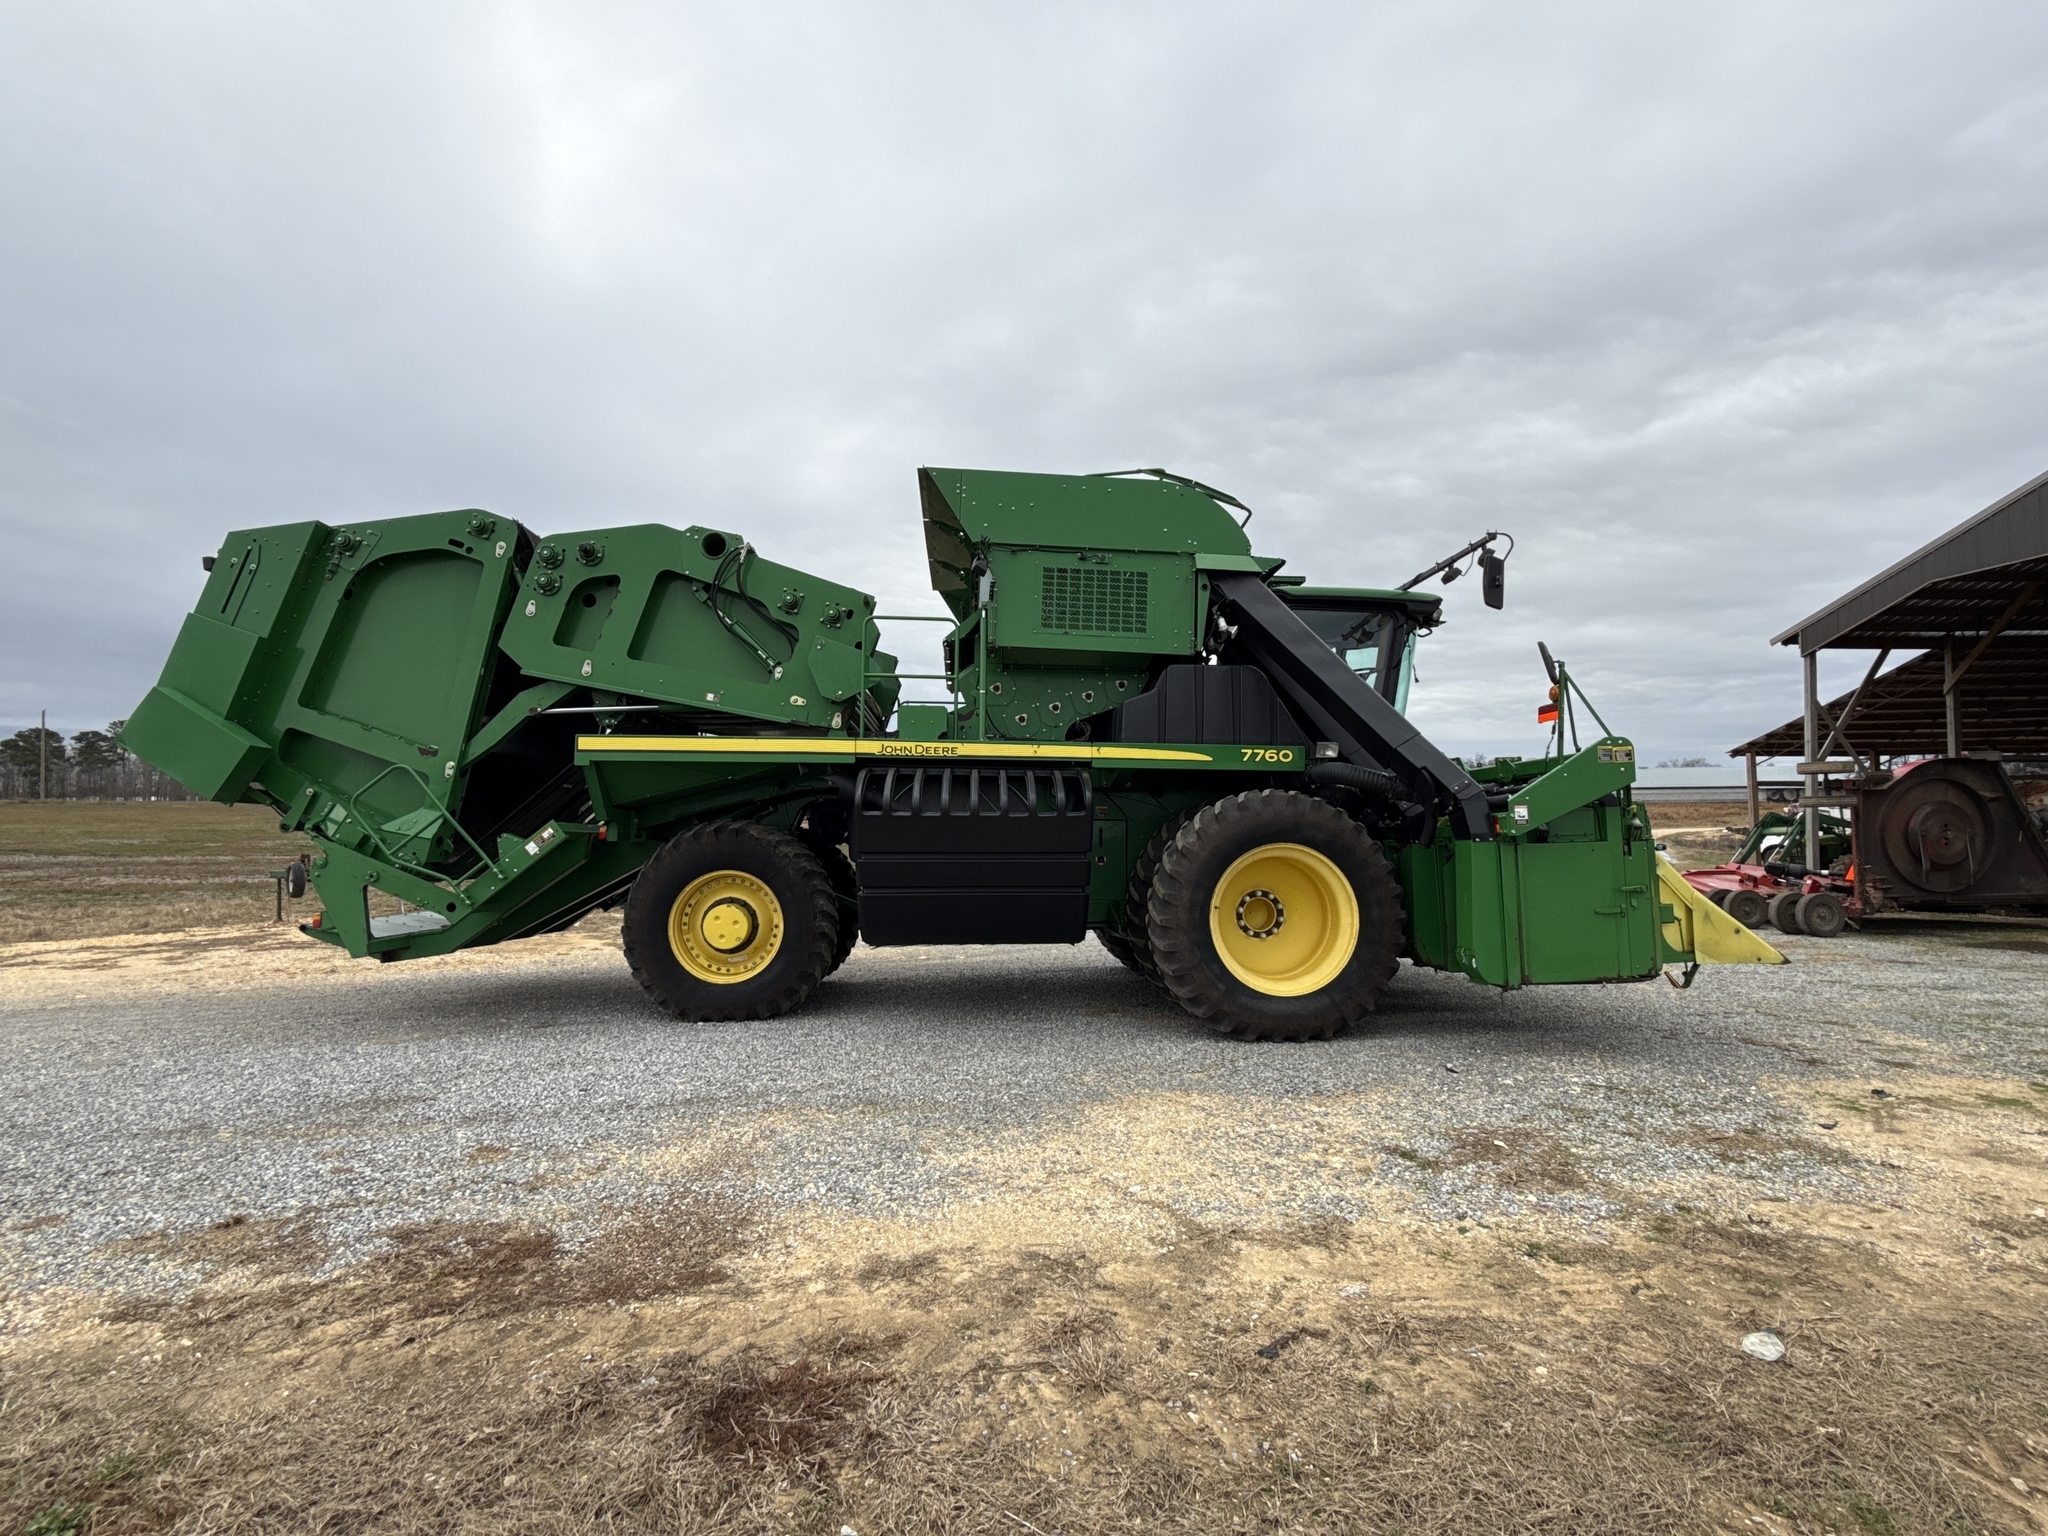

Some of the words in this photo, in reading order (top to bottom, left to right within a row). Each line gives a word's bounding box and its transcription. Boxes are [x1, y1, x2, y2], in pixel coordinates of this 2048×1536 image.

[877, 744, 913, 754] JOHN
[915, 744, 959, 755] DEERE
[1240, 748, 1294, 763] 7760
